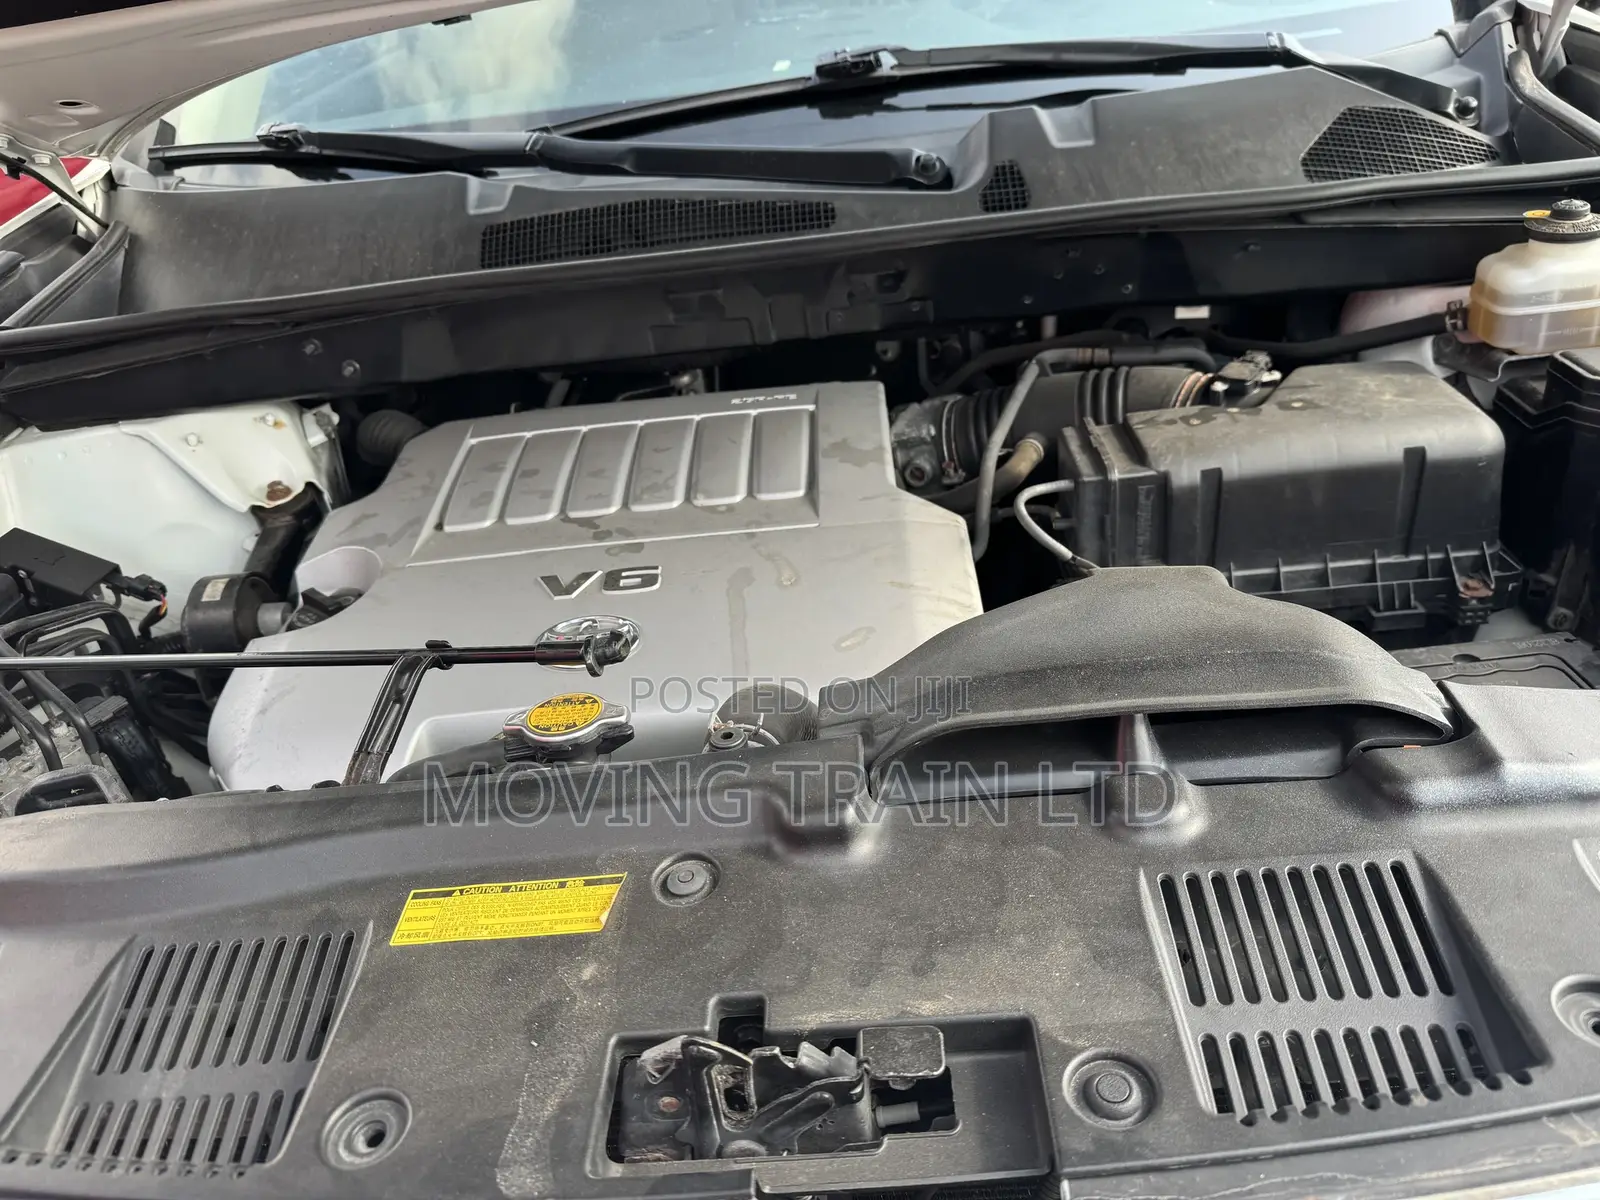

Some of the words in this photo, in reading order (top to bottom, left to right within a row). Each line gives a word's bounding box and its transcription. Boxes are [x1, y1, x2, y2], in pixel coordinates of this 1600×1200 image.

[536, 565, 663, 600] V6
[462, 886, 503, 896] CAUTION
[508, 881, 560, 893] ATTENTION
